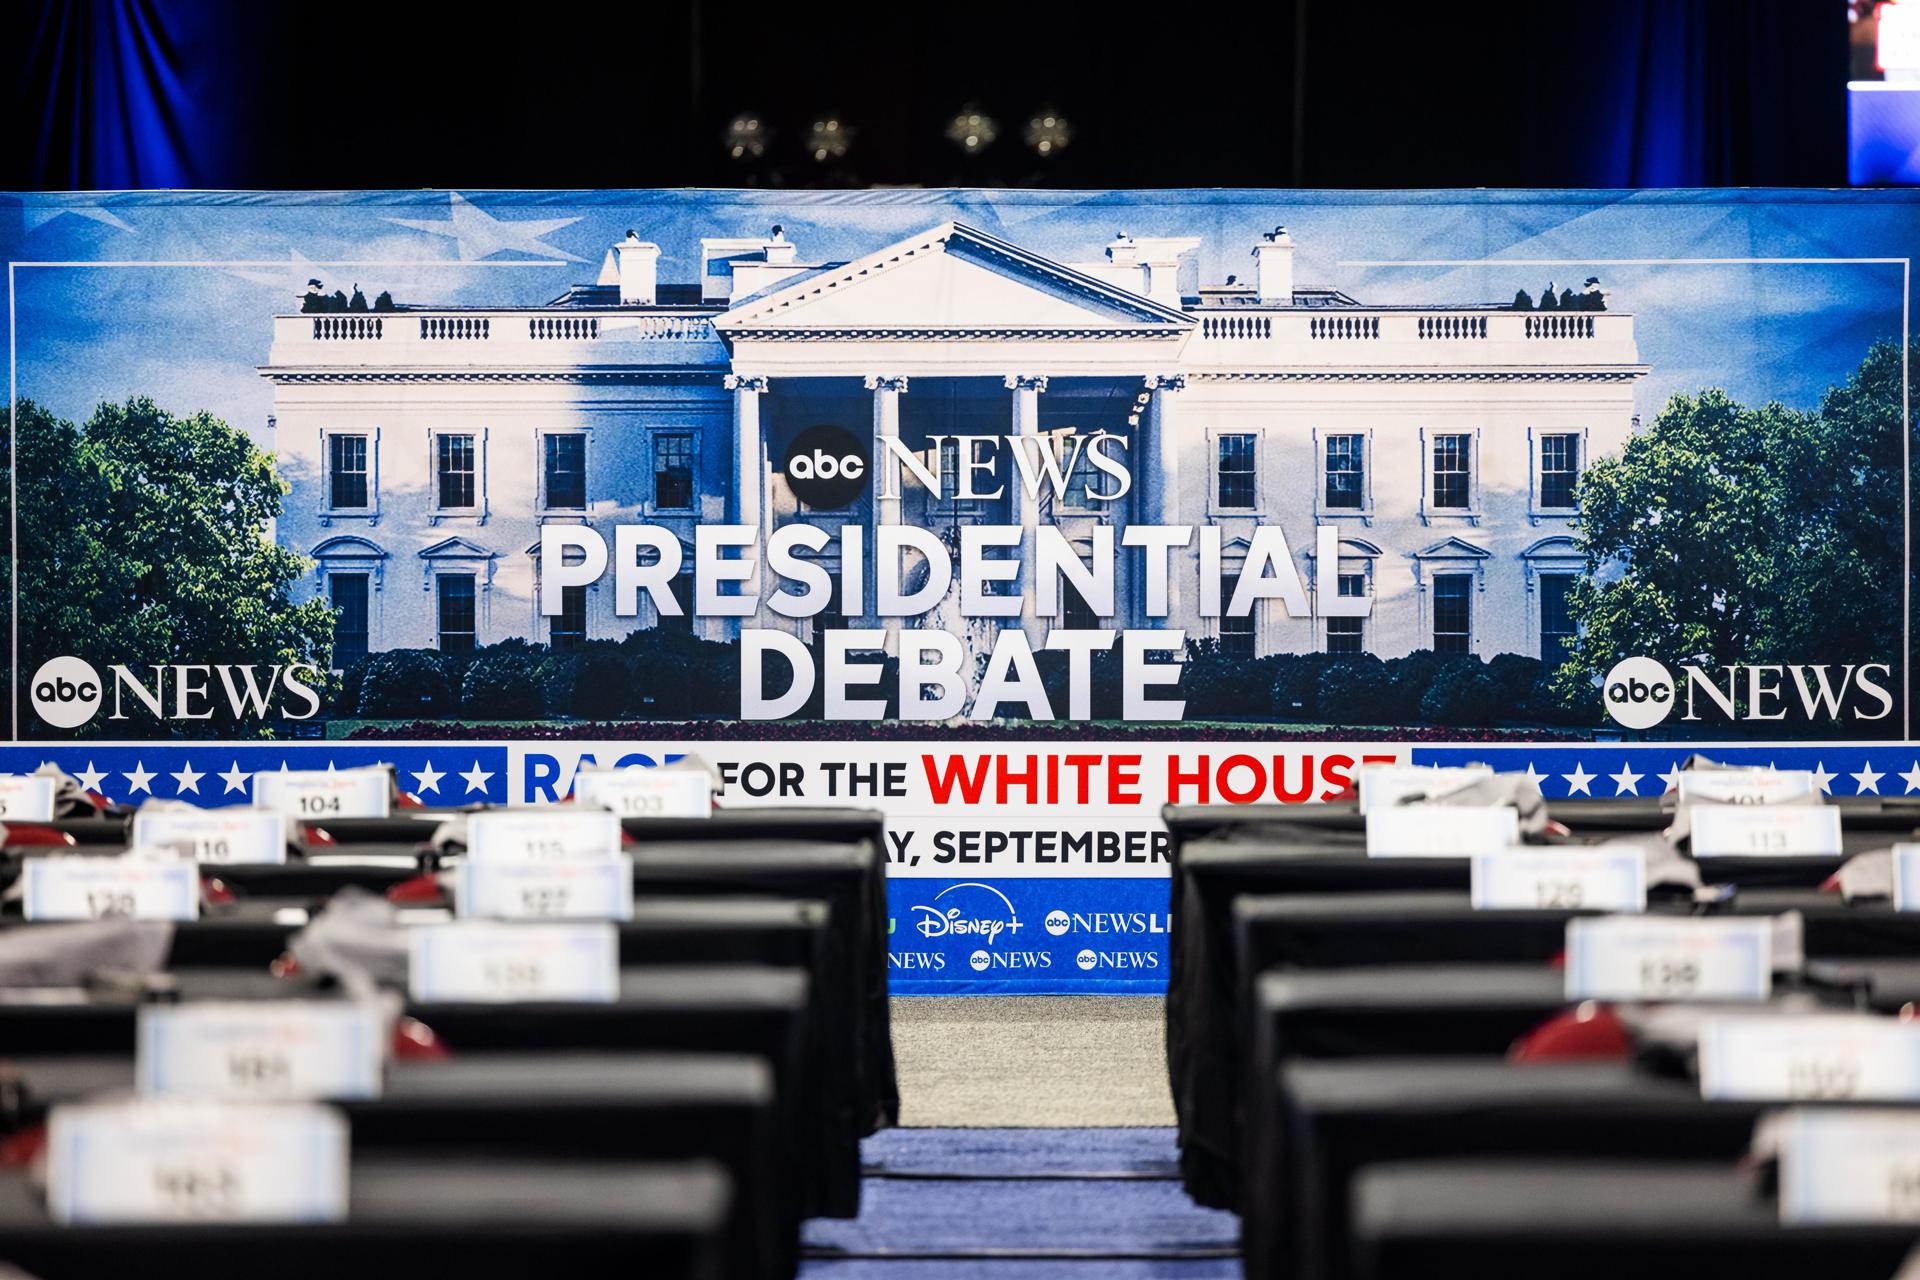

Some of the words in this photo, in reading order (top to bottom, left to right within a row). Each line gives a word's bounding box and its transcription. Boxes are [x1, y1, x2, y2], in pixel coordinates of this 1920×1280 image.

[789, 448, 865, 480] abc
[875, 434, 1132, 501] NEWS
[540, 523, 1373, 618] PRESIDENTIAL
[35, 676, 98, 703] abc
[107, 663, 320, 720] NEWS
[740, 629, 1186, 721] DEBATE
[1608, 677, 1671, 704] abc
[1680, 663, 1893, 721] NEWS
[717, 761, 806, 798] FOR
[820, 762, 908, 797] THE
[921, 754, 1143, 805] WHITE
[1167, 753, 1397, 805] HOUS
[299, 796, 341, 813] 104
[932, 830, 1173, 864] SEPTEMBER
[911, 905, 1024, 946] Disney+
[1046, 916, 1070, 928] abc
[1072, 912, 1146, 934] NEWS
[888, 951, 946, 970] NEWS
[970, 955, 990, 965] abc
[991, 951, 1052, 969] NEWS
[1077, 954, 1097, 964] abc
[1098, 951, 1159, 969] NEWS
